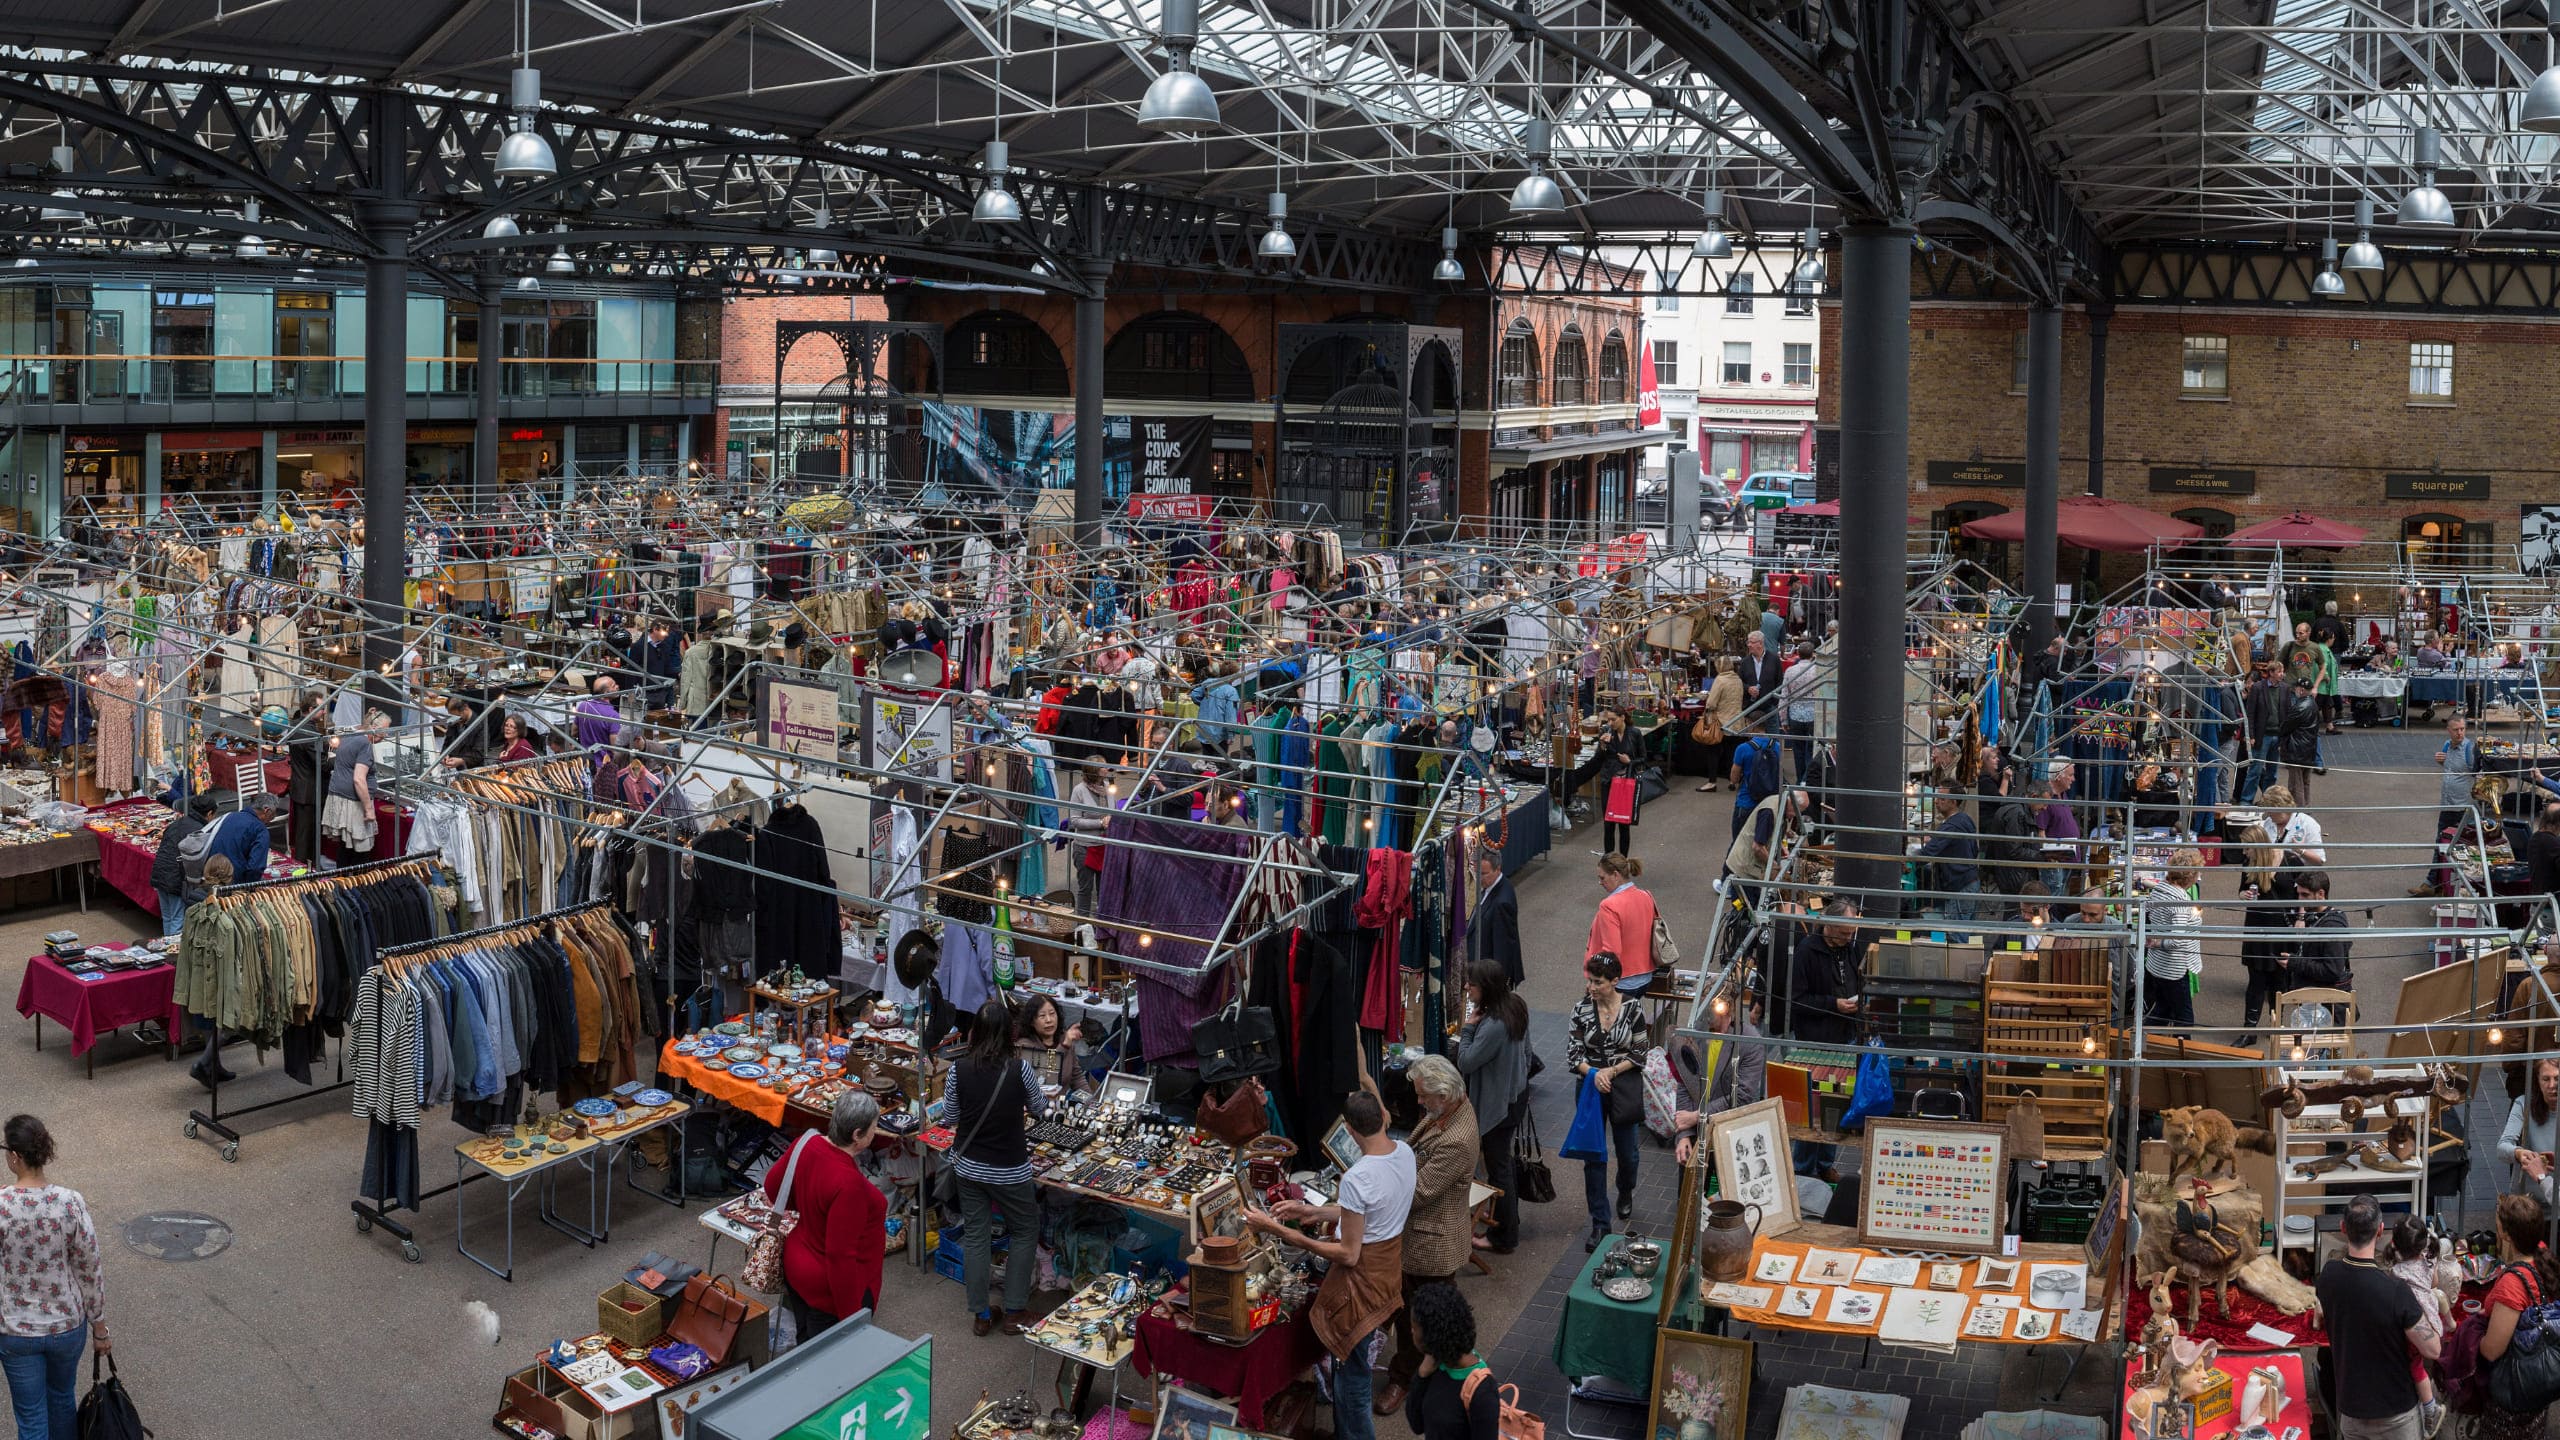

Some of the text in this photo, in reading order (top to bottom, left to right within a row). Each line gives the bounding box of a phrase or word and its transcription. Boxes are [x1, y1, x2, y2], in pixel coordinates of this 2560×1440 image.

[1715, 407, 1762, 415] SPITALFIELDS
[1143, 423, 1166, 439] THE
[1145, 441, 1181, 458] COWS
[1143, 459, 1167, 476] ARE
[1952, 472, 2004, 481] CHEESE SHOP
[1144, 477, 1191, 494] COMING
[2175, 479, 2205, 487] CHEESE
[2211, 480, 2230, 488] WINE
[2412, 482, 2448, 493] square
